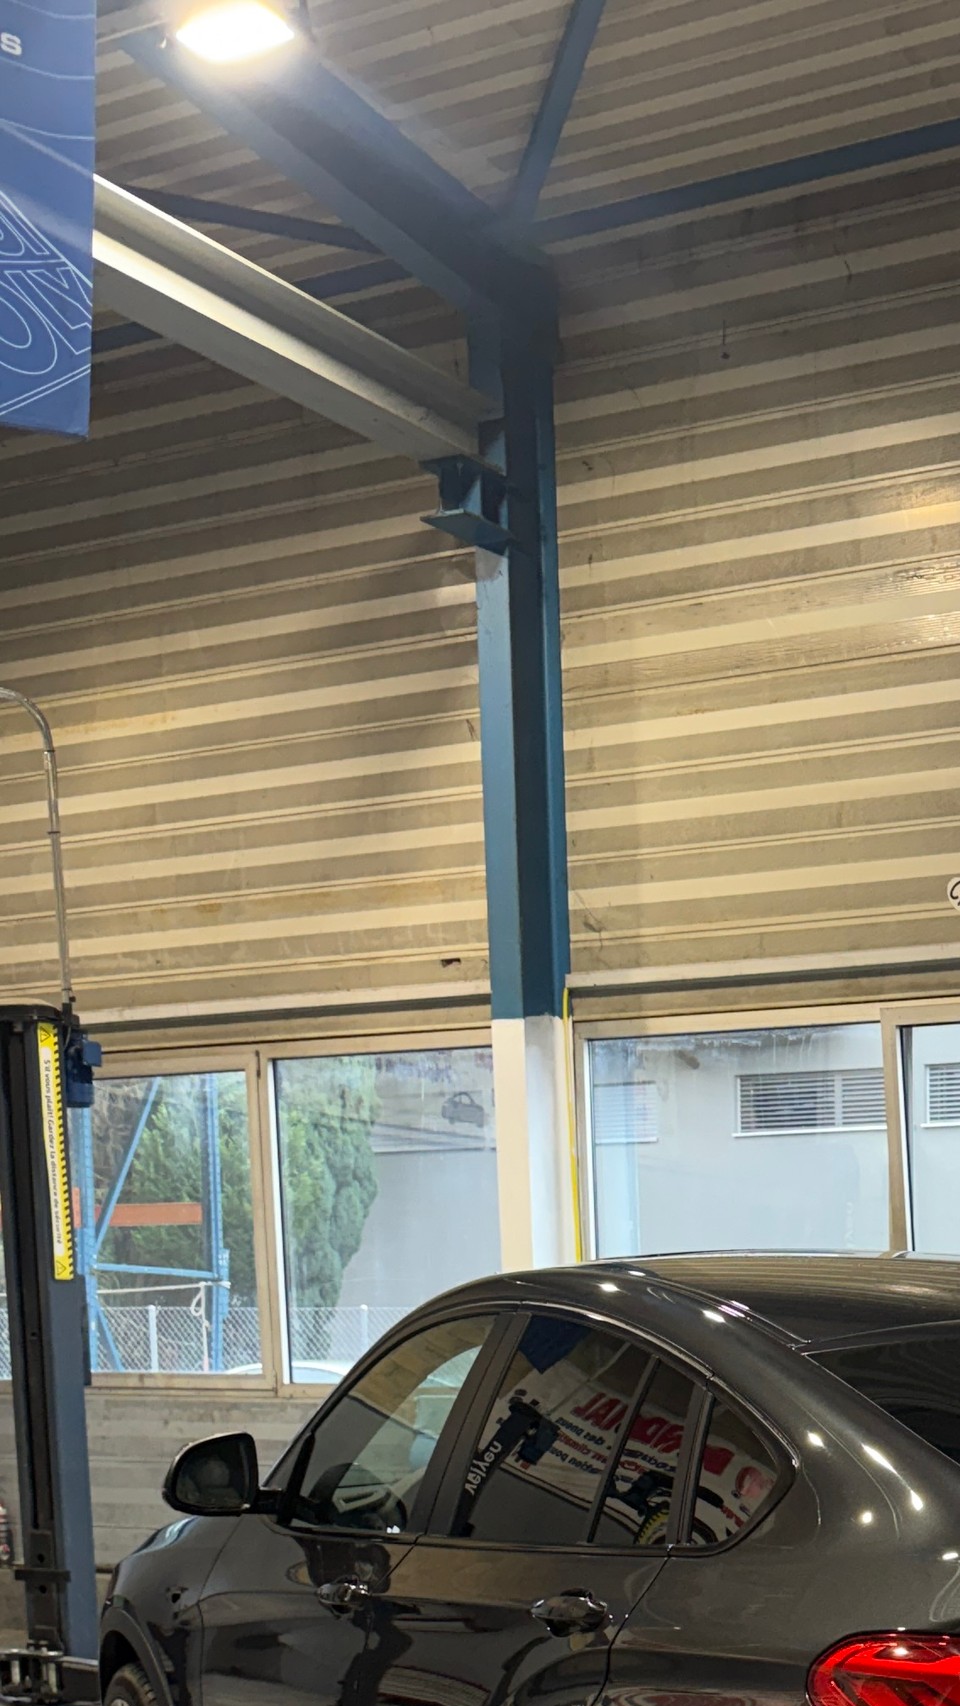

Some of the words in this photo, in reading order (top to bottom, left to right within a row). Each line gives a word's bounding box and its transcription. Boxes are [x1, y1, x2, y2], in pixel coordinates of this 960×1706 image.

[44, 1073, 52, 1094] vous
[47, 1119, 56, 1149] Gardez
[50, 1160, 59, 1197] distance
[53, 1198, 60, 1209] de
